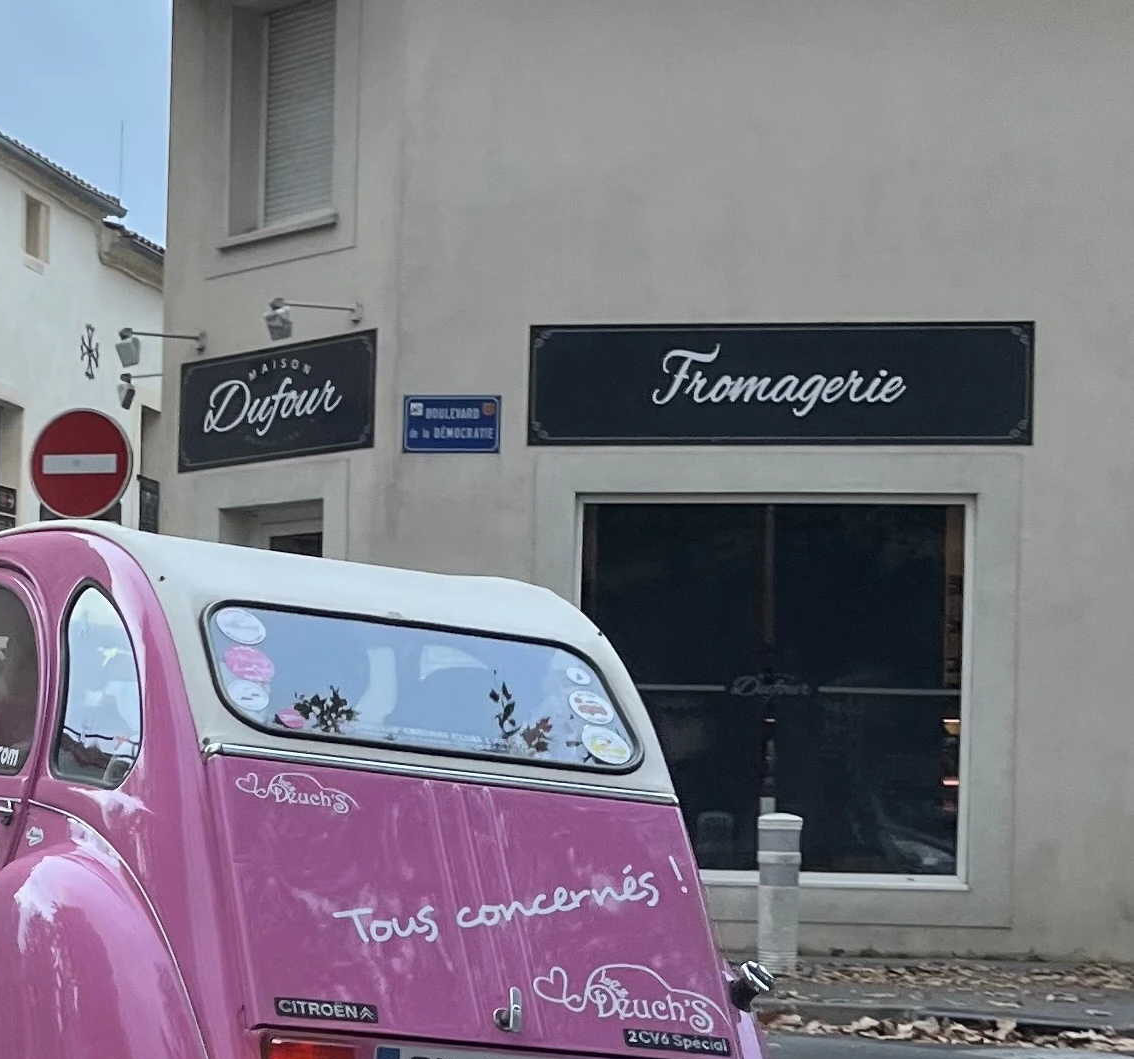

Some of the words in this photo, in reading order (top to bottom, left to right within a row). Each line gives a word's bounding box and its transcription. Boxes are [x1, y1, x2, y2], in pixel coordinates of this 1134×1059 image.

[248, 358, 312, 381] MAISON
[652, 343, 907, 417] Fromagerie
[203, 376, 343, 437] Dufour
[425, 407, 480, 419] BOULEVARD
[433, 425, 494, 439] DÉMOCRATIE
[333, 905, 439, 942] Tous
[456, 865, 659, 927] concernés
[278, 999, 358, 1019] CITROËN
[627, 1030, 670, 1045] 2CV6
